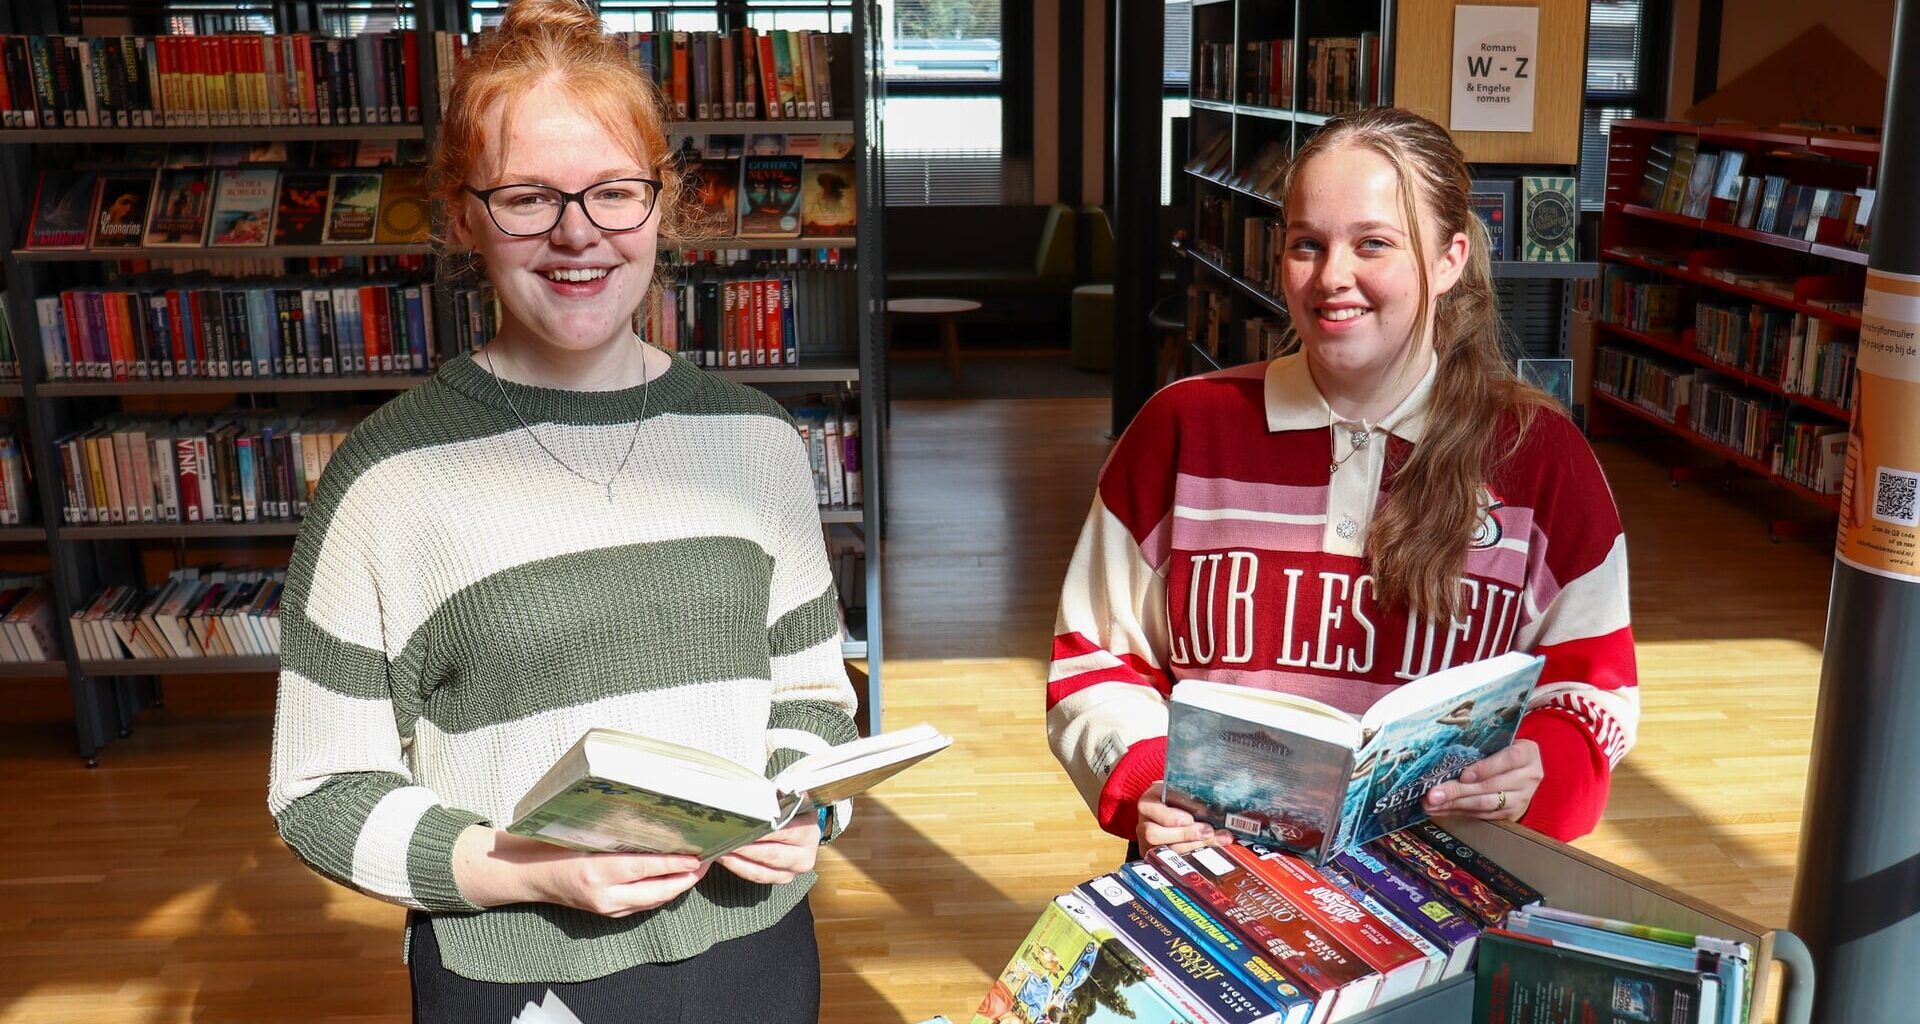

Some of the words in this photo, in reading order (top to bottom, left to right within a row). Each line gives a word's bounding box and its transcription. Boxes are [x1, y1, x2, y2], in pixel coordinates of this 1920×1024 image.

[1480, 43, 1517, 52] Romans
[1467, 56, 1493, 77] W
[1514, 57, 1529, 78] Z
[1466, 83, 1474, 92] &
[1476, 83, 1511, 95] Engelse
[1476, 95, 1511, 103] romans
[748, 161, 798, 170] GOUDEN
[226, 188, 267, 196] ROBERTS
[100, 211, 111, 222] De
[766, 284, 774, 314] VUUREN
[1885, 345, 1895, 355] op
[1895, 344, 1905, 357] bij
[1906, 346, 1917, 356] de
[1167, 552, 1259, 665] LUB
[1277, 568, 1377, 673] LES
[1395, 578, 1524, 680] DEU
[1246, 873, 1263, 886] HELD
[1235, 879, 1296, 922] OLYMPUS
[1264, 887, 1298, 914] VERLOREN
[1127, 912, 1138, 922] DE
[1137, 919, 1149, 929] EN
[1142, 911, 1173, 937] GRIEKSE
[1361, 928, 1383, 945] PHILIP
[1363, 923, 1393, 945] PULLMAN
[1383, 916, 1421, 946] Kameleon
[1226, 939, 1239, 951] DE
[1303, 930, 1347, 965] RIORDAN
[1305, 941, 1331, 961] RICK
[1165, 937, 1225, 982] JACKSON
[1167, 949, 1201, 980] PERCY
[1243, 961, 1273, 983] MARCUS
[1219, 981, 1262, 1017] RIORDAN
[1219, 993, 1243, 1013] RICK
